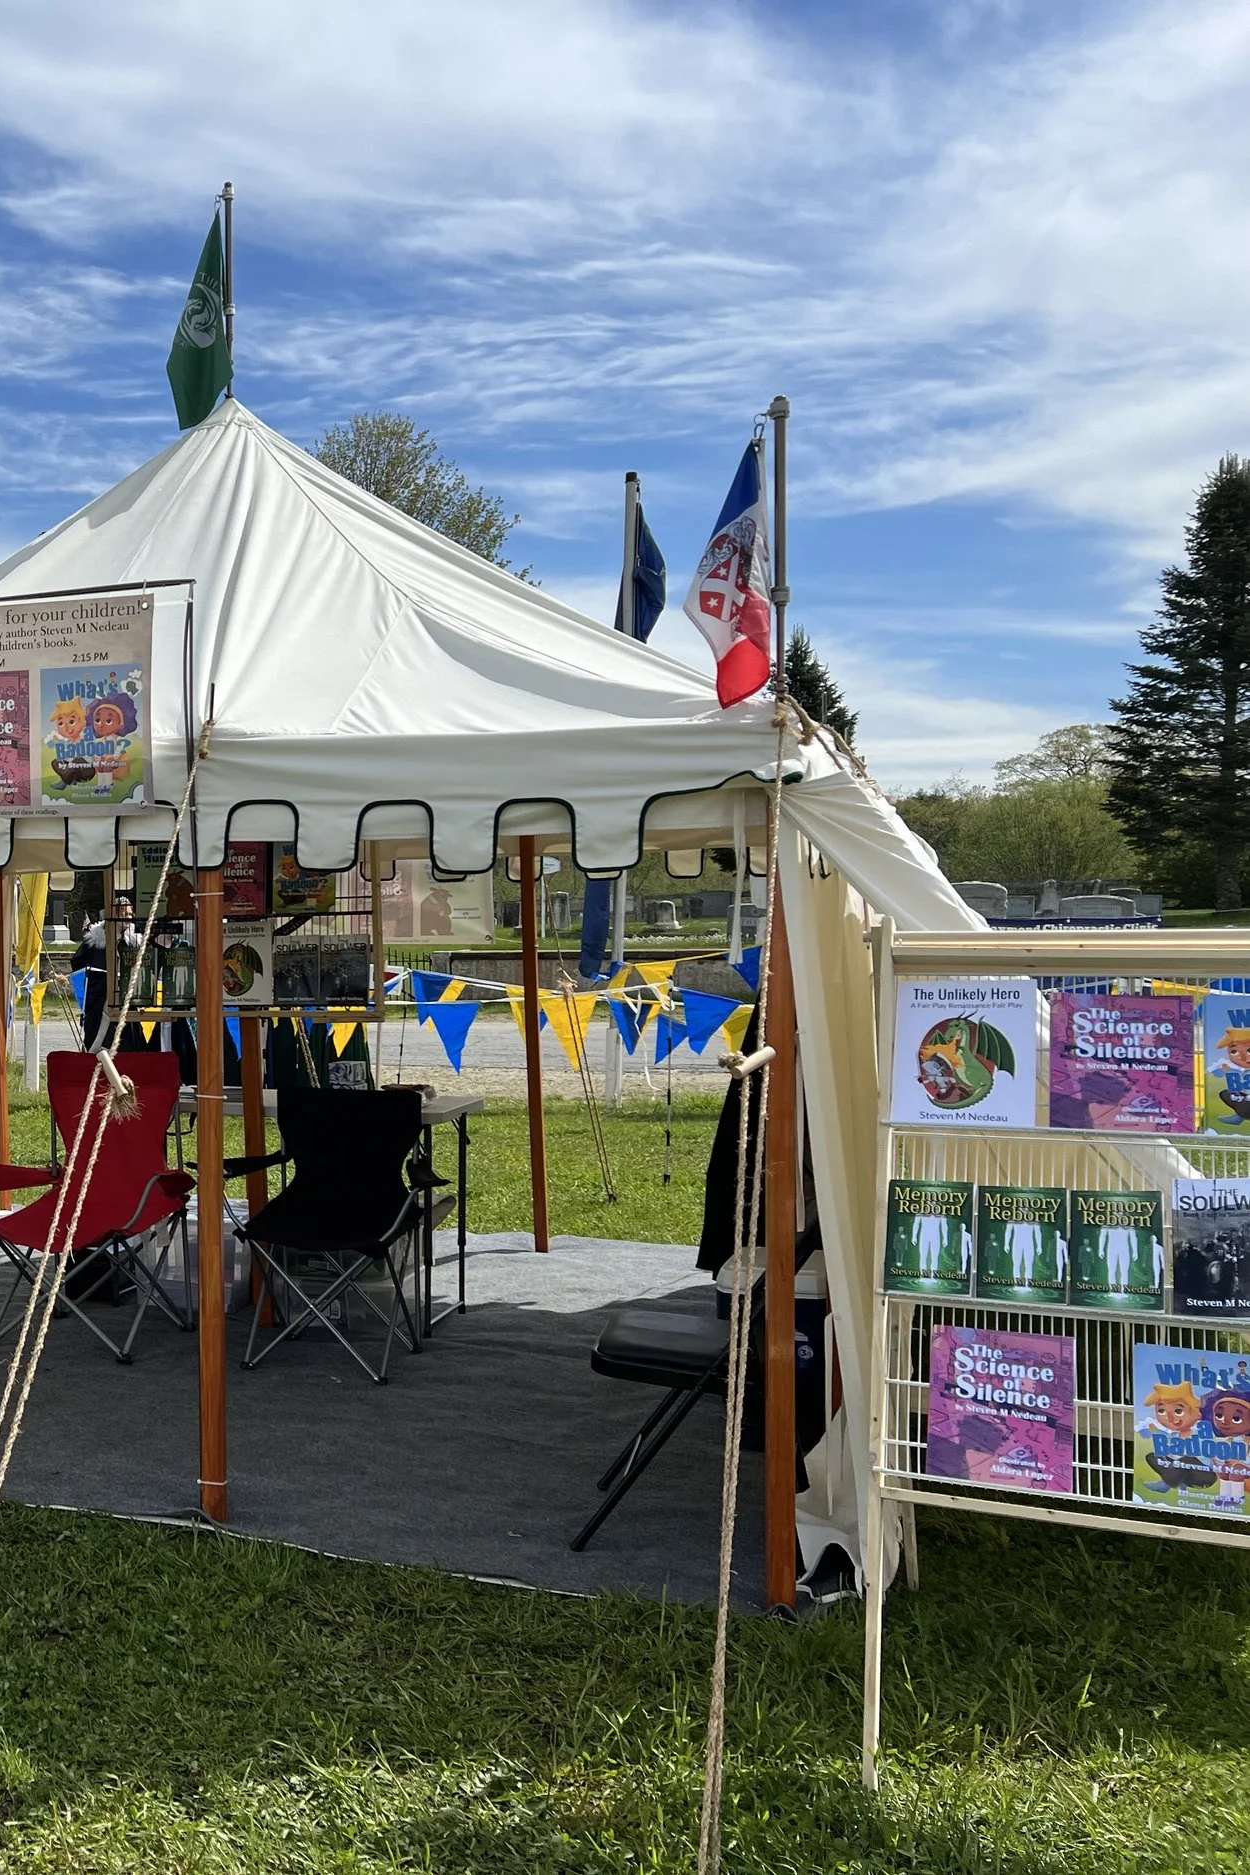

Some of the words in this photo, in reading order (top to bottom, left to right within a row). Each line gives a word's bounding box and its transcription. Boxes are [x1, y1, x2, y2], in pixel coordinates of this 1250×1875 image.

[6, 609, 27, 625] for
[32, 609, 67, 626] your
[71, 600, 142, 620] children!
[5, 627, 38, 638] author
[40, 625, 73, 637] Steven
[76, 623, 86, 634] M
[89, 621, 130, 633] Nedeau
[44, 637, 77, 648] books.
[72, 653, 92, 663] 2:15
[94, 652, 109, 661] PM
[57, 679, 119, 702] What's
[84, 725, 94, 740] a
[54, 739, 132, 761] Badoon?
[913, 988, 934, 1001] The
[938, 988, 987, 1002] Unlikely
[991, 988, 1021, 1000] Hero
[932, 1002, 947, 1010] Play
[1008, 1001, 1024, 1009] Play
[1089, 1007, 1121, 1020] The
[1072, 1011, 1174, 1036] Science
[1075, 1035, 1171, 1060] Silence
[1122, 1035, 1141, 1047] of
[1086, 1062, 1118, 1071] Steven
[1121, 1063, 1130, 1071] M
[1131, 1063, 1169, 1072] Nedeau
[919, 1111, 954, 1120] Steven
[955, 1112, 966, 1121] M
[968, 1113, 1008, 1122] Nedeau
[894, 1186, 968, 1207] Memory
[984, 1193, 1061, 1213] Memory
[899, 1200, 962, 1216] Reborn
[1077, 1196, 1157, 1214] Memory
[989, 1206, 1056, 1223] Reborn
[1082, 1210, 1151, 1227] Reborn
[890, 1267, 921, 1277] Steven
[921, 1269, 932, 1278] M
[933, 1270, 968, 1280] Nedeau
[982, 1275, 1015, 1285] Steven
[1016, 1277, 1026, 1286] M
[1027, 1278, 1064, 1289] Nedeau
[1076, 1281, 1109, 1291] Steven
[1110, 1284, 1122, 1293] M
[1123, 1284, 1161, 1295] Nedeau
[1186, 1298, 1223, 1308] Steven
[1225, 1299, 1235, 1308] M
[971, 1344, 1003, 1360] The
[954, 1347, 1055, 1382] Science
[955, 1373, 1051, 1409] Silence
[1003, 1377, 1022, 1392] of
[965, 1404, 998, 1416] Steven
[999, 1408, 1009, 1416] M
[1011, 1409, 1048, 1423] Nedeau
[1196, 1420, 1214, 1439] a
[990, 1464, 1023, 1477] Aldara
[1025, 1468, 1055, 1481] Lopez
[1157, 1458, 1170, 1468] by
[1173, 1460, 1211, 1472] Steven
[1213, 1466, 1223, 1474] M
